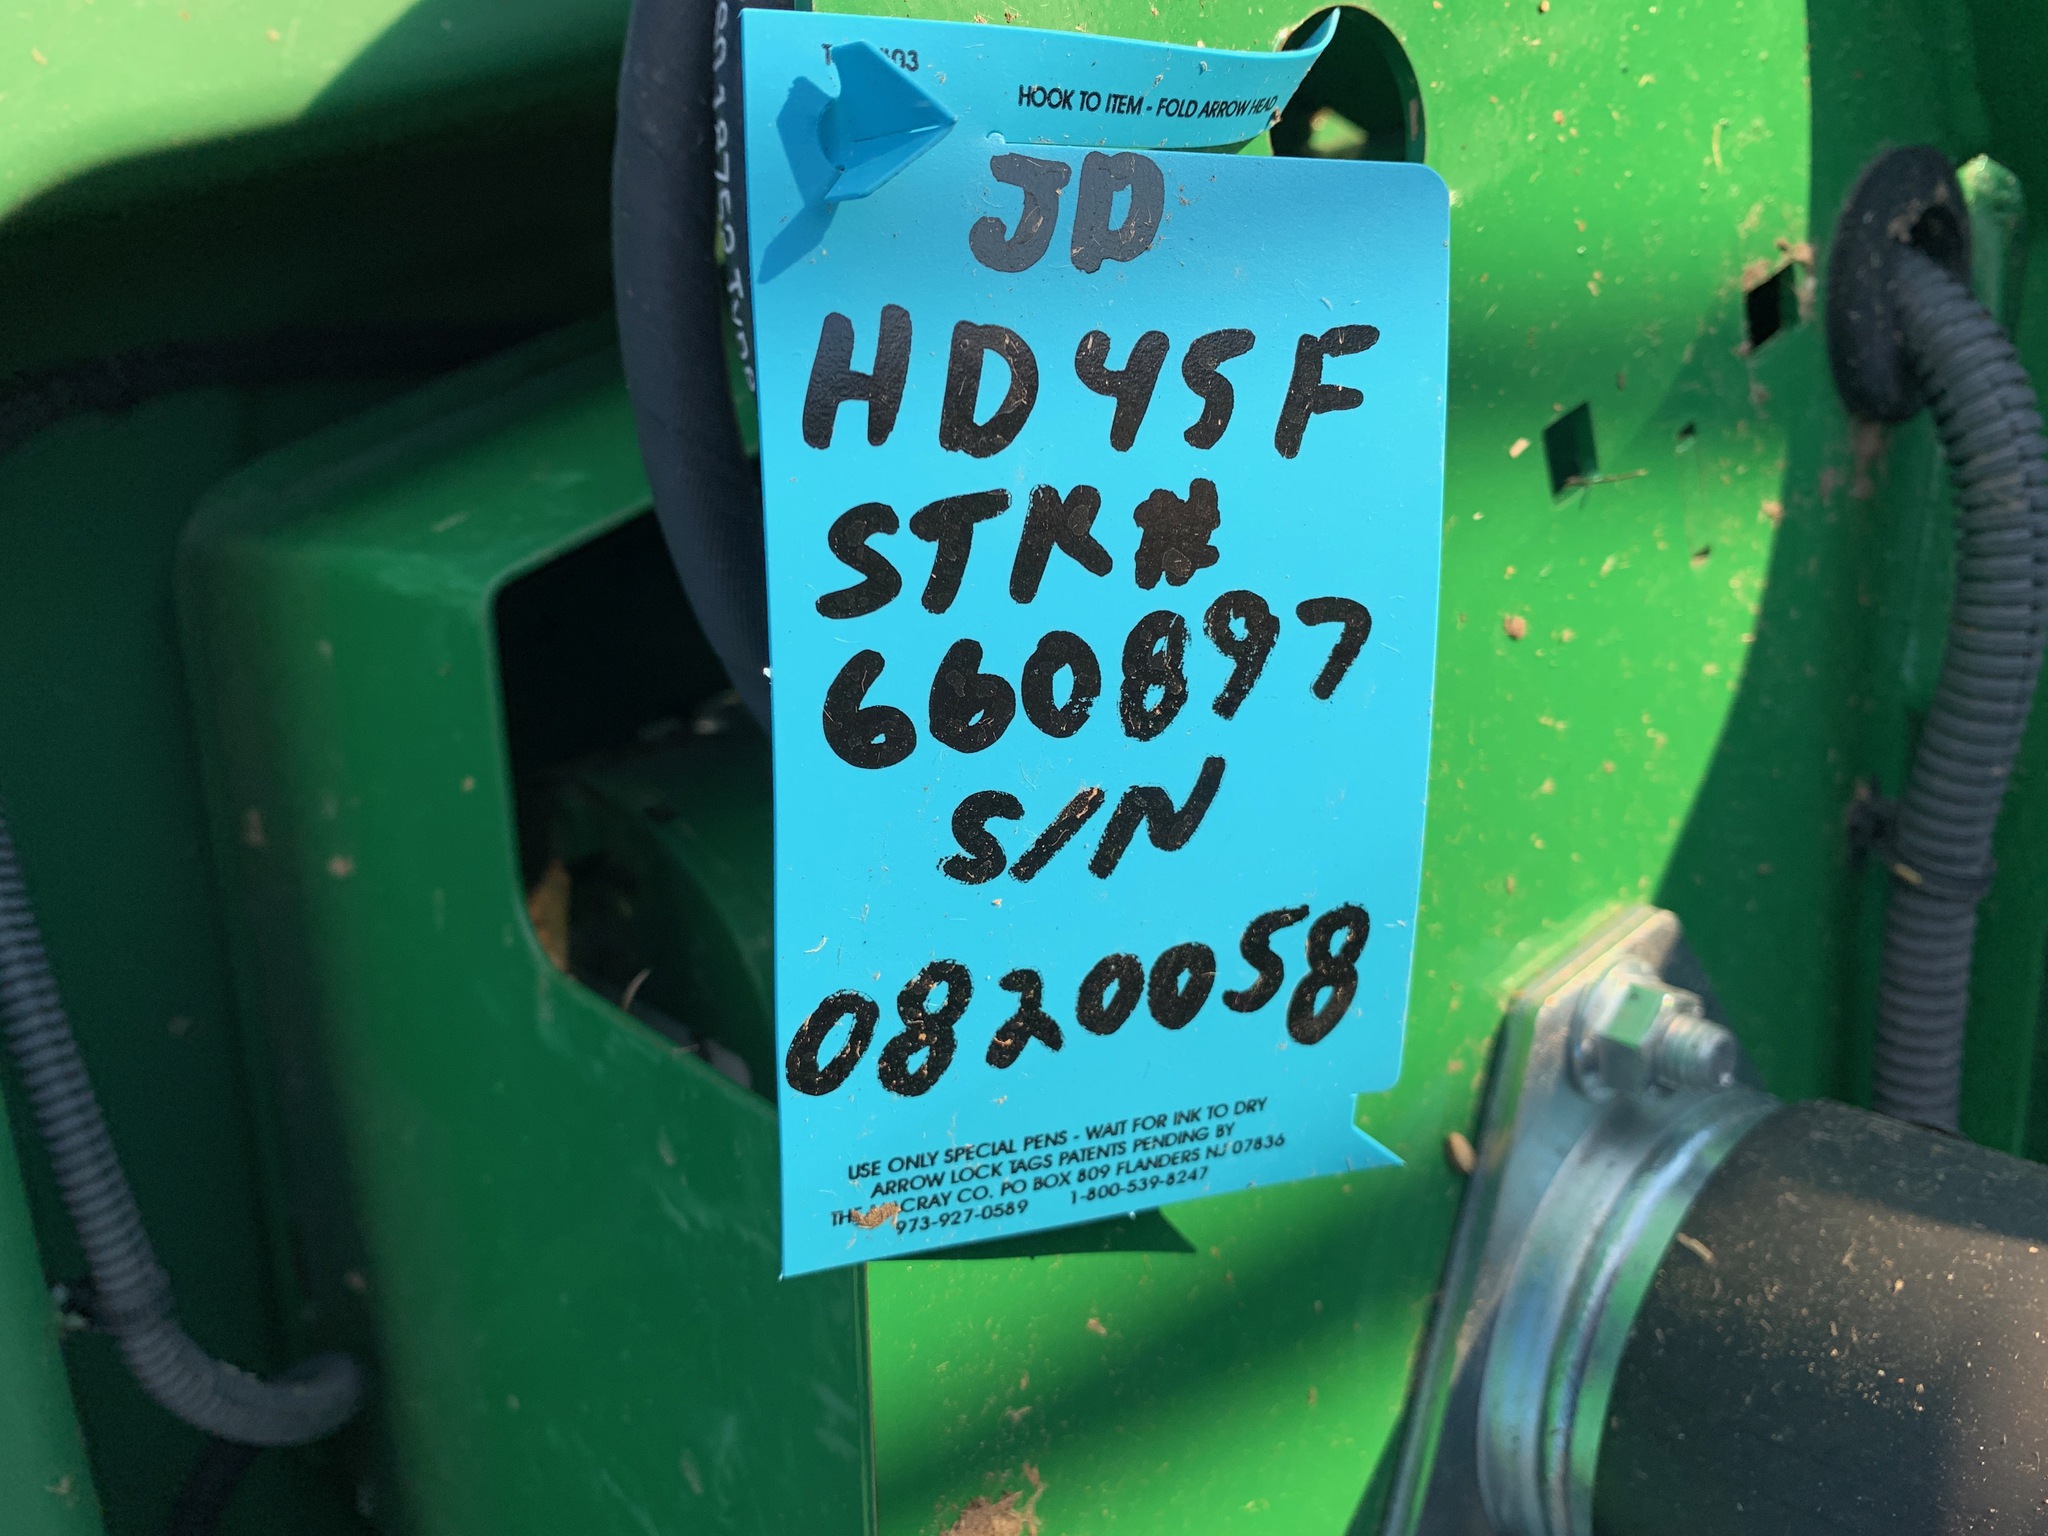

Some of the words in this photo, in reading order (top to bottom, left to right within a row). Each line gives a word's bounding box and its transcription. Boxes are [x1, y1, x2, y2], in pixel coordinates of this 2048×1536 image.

[1018, 84, 1075, 111] HOOK
[1079, 90, 1102, 112] TO
[1104, 92, 1145, 116] ITEM
[1155, 97, 1199, 119] FOLD
[1198, 97, 1251, 119] ARROW
[1247, 95, 1279, 116] HEAD
[970, 149, 1165, 274] JD
[822, 589, 1374, 770] 660897
[937, 756, 1226, 887] S/N
[785, 902, 1371, 1098] 0820058
[848, 1159, 882, 1181] USE
[887, 1150, 939, 1174] ONLY
[943, 1138, 1017, 1165] SPECIAL
[1023, 1130, 1068, 1152] PENS
[1085, 1118, 1128, 1141] WAIT
[1132, 1113, 1168, 1134] FOR
[1172, 1107, 1202, 1126] INK
[1206, 1103, 1229, 1121] TO
[1233, 1096, 1268, 1116] DRY
[866, 1190, 952, 1217] CRAY
[956, 1185, 994, 1204] CO.
[1000, 1178, 1028, 1197] PO
[1032, 1170, 1071, 1192] BOX
[1076, 1164, 1111, 1184] 809
[1115, 1147, 1201, 1176] FLANDERS
[1205, 1142, 1229, 1160] NJ
[1232, 1133, 1286, 1155] 07836
[870, 1171, 946, 1199] ARROW
[950, 1161, 1003, 1185] LOCK
[1008, 1152, 1053, 1175] TAGS
[1058, 1140, 1127, 1167] PATENTS
[1131, 1126, 1210, 1153] PENDING
[1215, 1121, 1236, 1139] BY
[895, 1199, 1029, 1236] 973-927-0589
[1070, 1165, 1209, 1205] 1-800-539-8247
